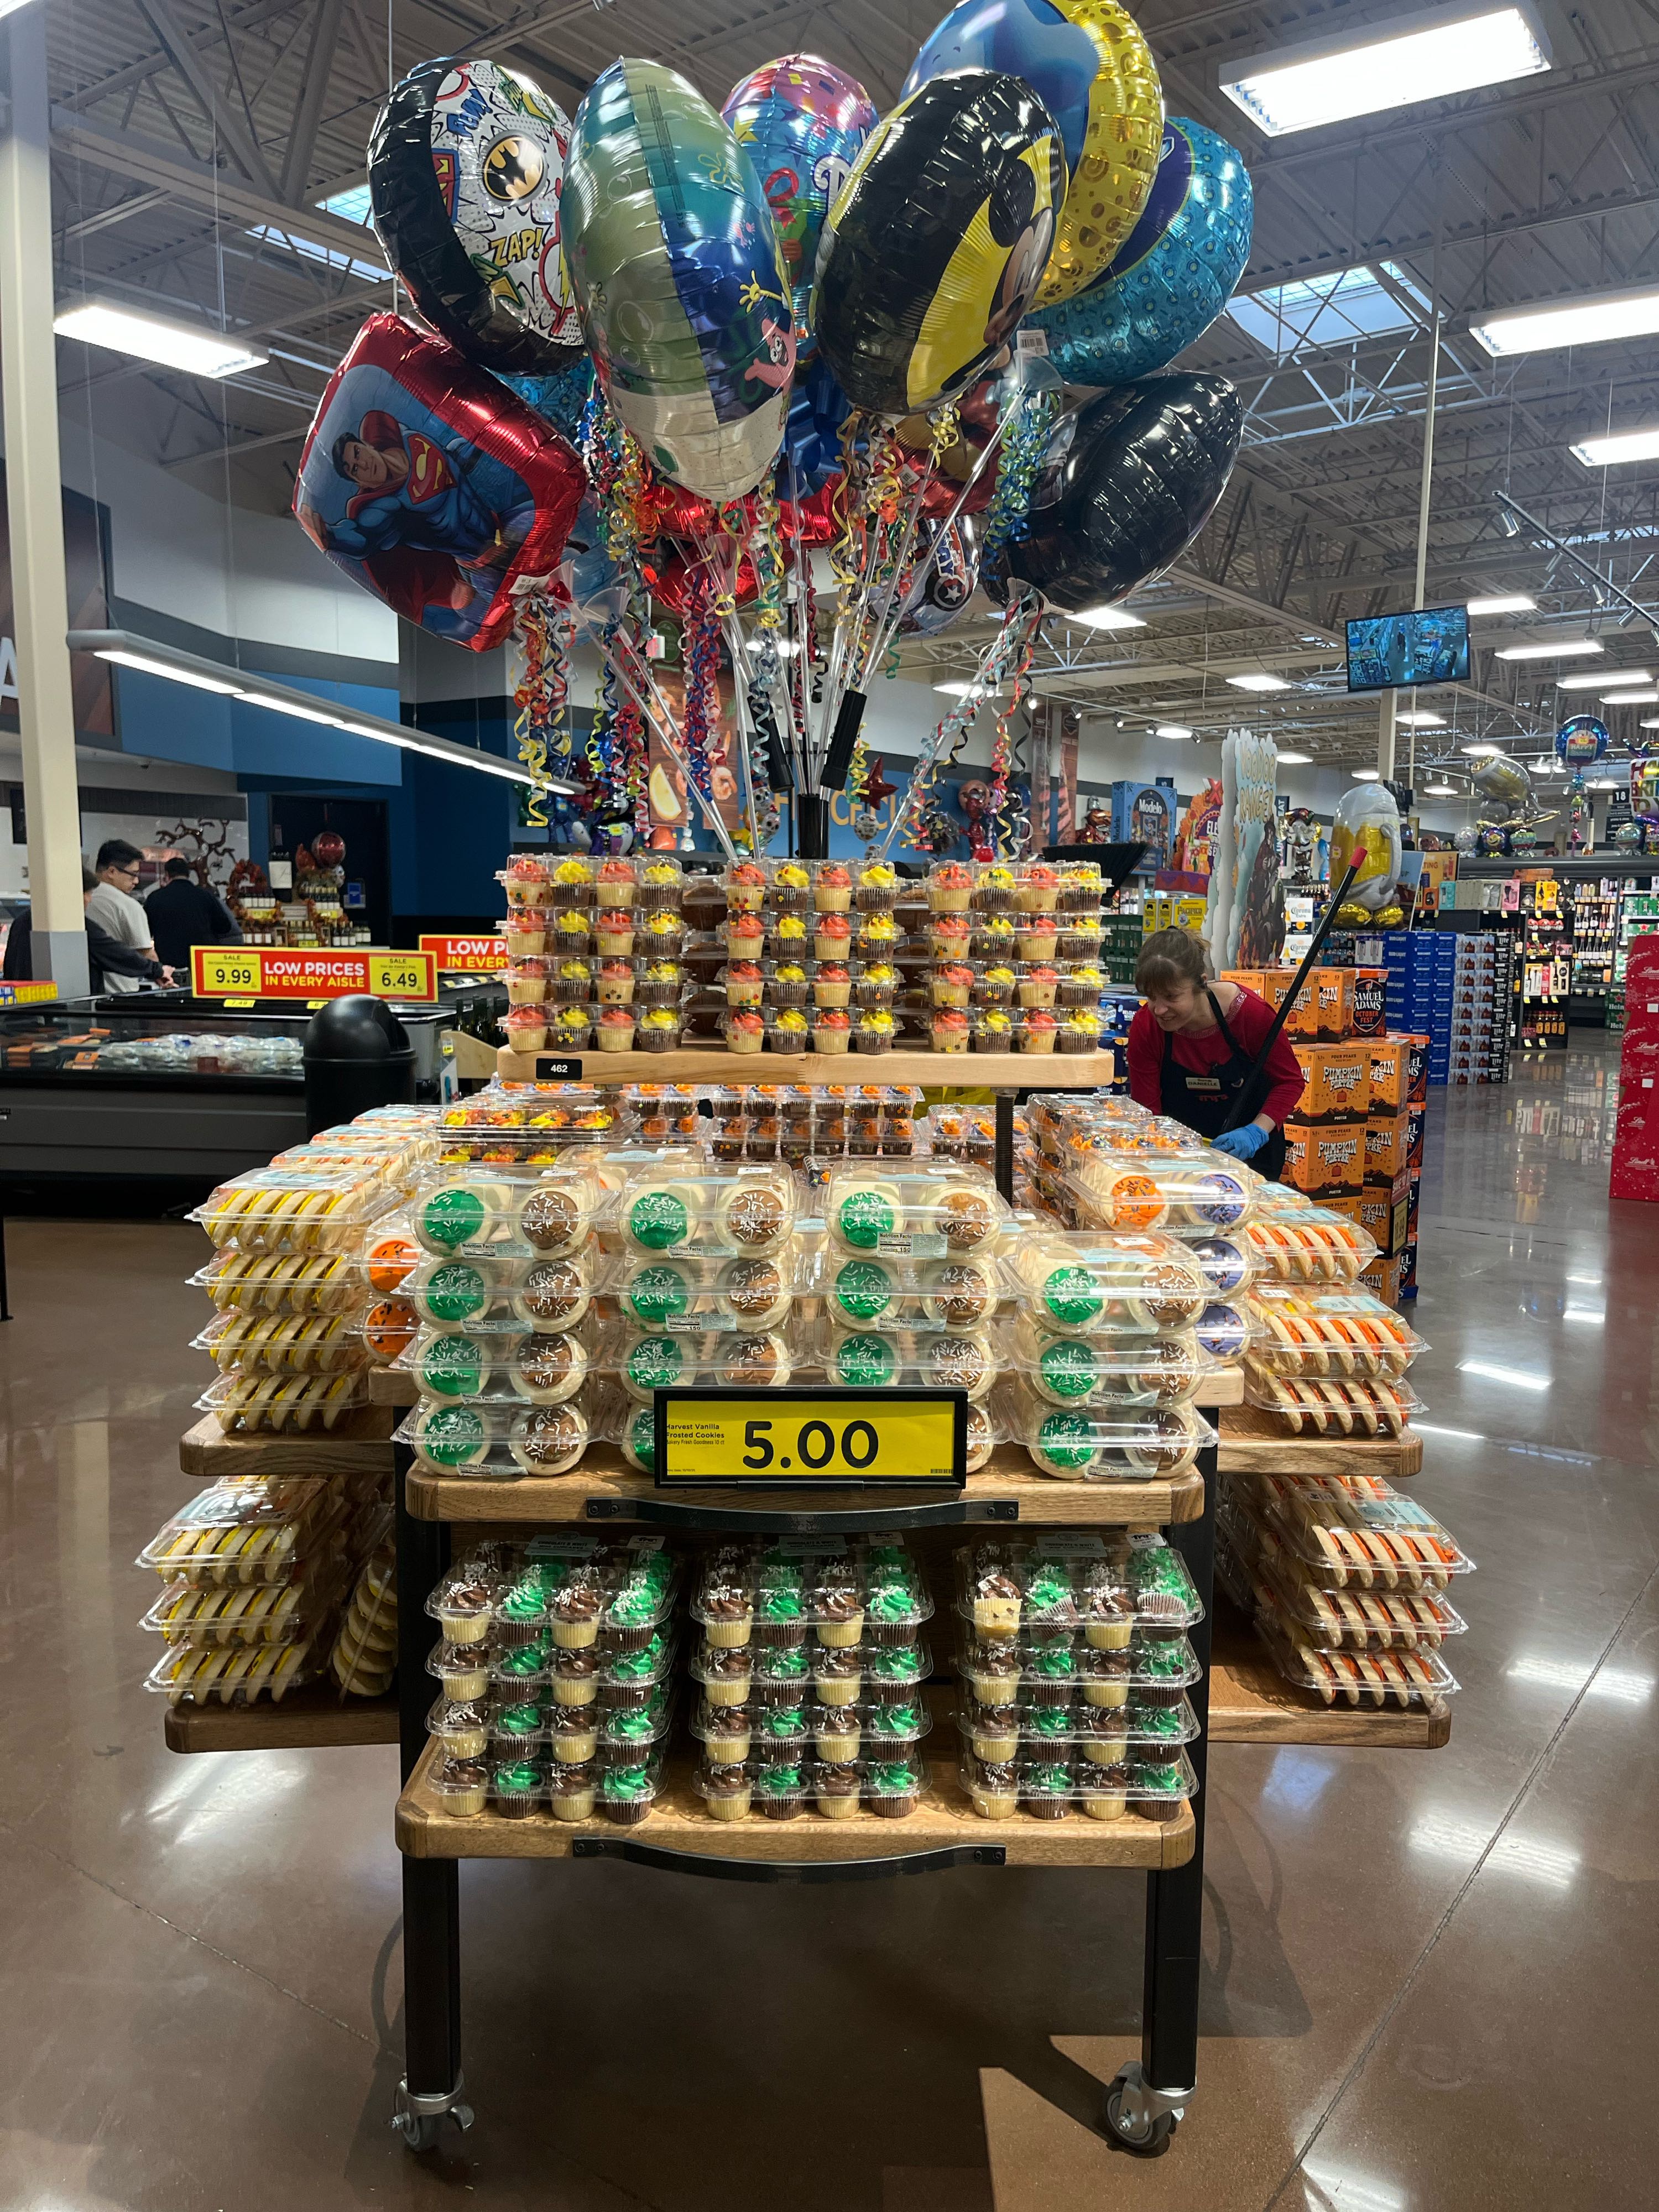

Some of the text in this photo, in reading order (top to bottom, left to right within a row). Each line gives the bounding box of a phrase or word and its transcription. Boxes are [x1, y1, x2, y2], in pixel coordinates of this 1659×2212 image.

[489, 228, 544, 268] ZAP!
[1615, 791, 1626, 801] 18
[1139, 799, 1162, 815] Modelo
[1240, 785, 1274, 824] RANGER
[447, 941, 489, 955] LOW
[265, 961, 364, 977] LOW PRICES
[447, 956, 465, 968] IN
[216, 969, 251, 984] 9.99
[265, 975, 365, 988] IN EVERY AISLE
[382, 972, 418, 988] 6.49
[1275, 987, 1312, 1003] PUKIN
[1354, 991, 1384, 1001] SAMUEL
[1354, 1001, 1381, 1011] ADAMS
[1323, 1064, 1363, 1083] PUMPKIN
[1329, 1078, 1355, 1092] PORTER
[1317, 1138, 1358, 1158] PUMPKIN
[1325, 1153, 1349, 1166] PORTER
[742, 1420, 879, 1469] 5.00
